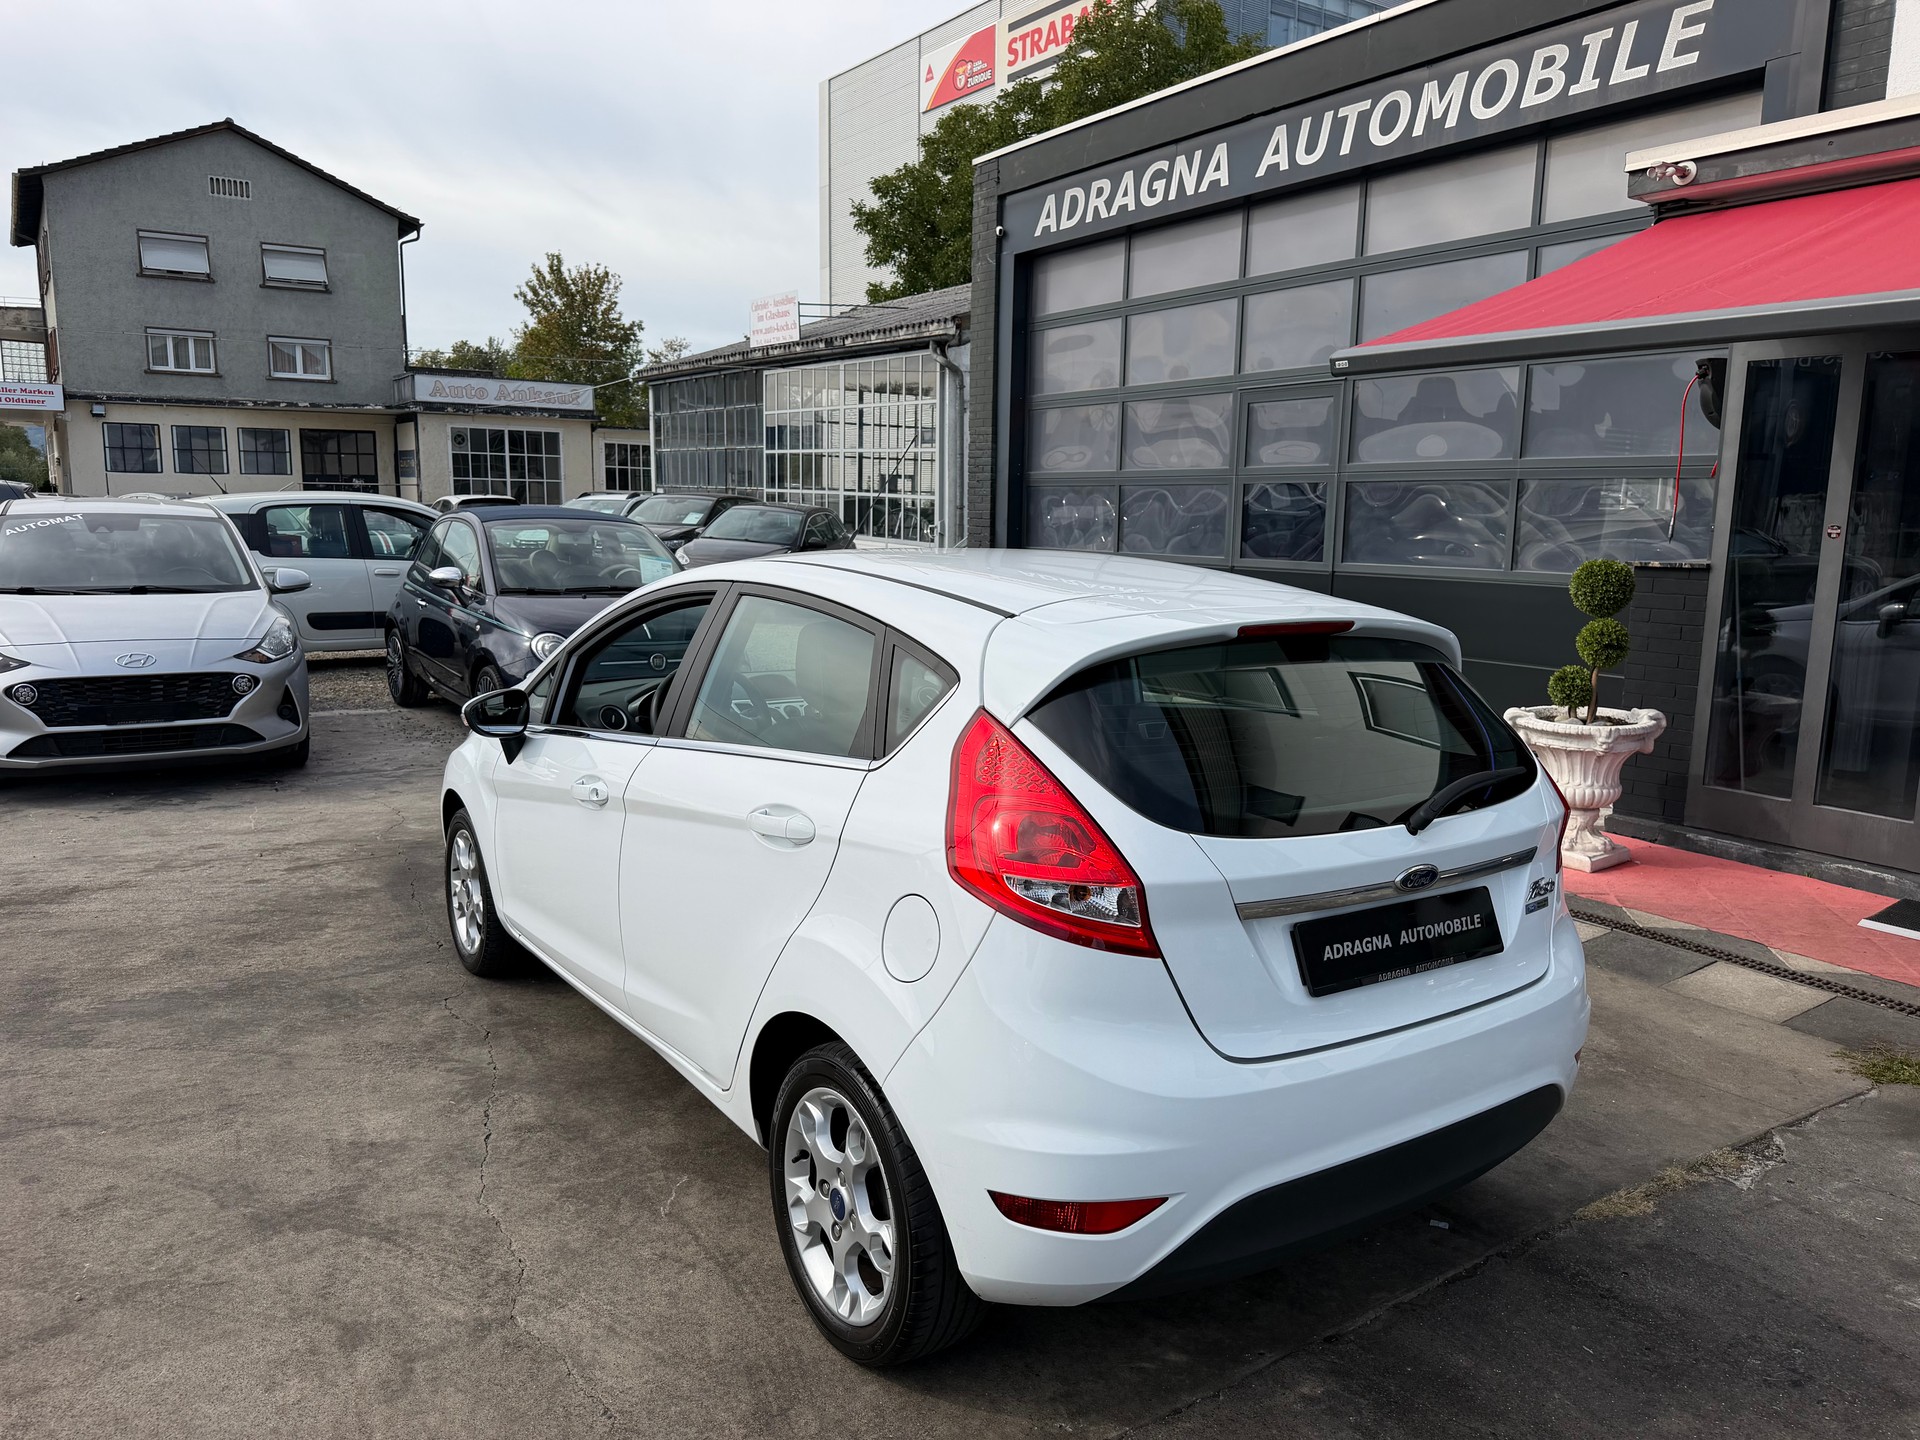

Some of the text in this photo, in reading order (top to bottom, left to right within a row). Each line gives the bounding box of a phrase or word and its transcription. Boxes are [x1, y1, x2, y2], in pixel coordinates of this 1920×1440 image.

[967, 69, 992, 88] ZURIQUE
[1034, 3, 1711, 237] ADRAGNA AUTOMOBILE
[20, 387, 54, 395] Marken
[429, 380, 581, 406] Auto Ankauf
[5, 513, 83, 536] AUTOMAT
[1406, 871, 1434, 888] Ford
[1323, 913, 1482, 961] ADRAGNA AUTOMOBILE
[1378, 956, 1455, 982] ADRAGNA AUTOMOBILE
